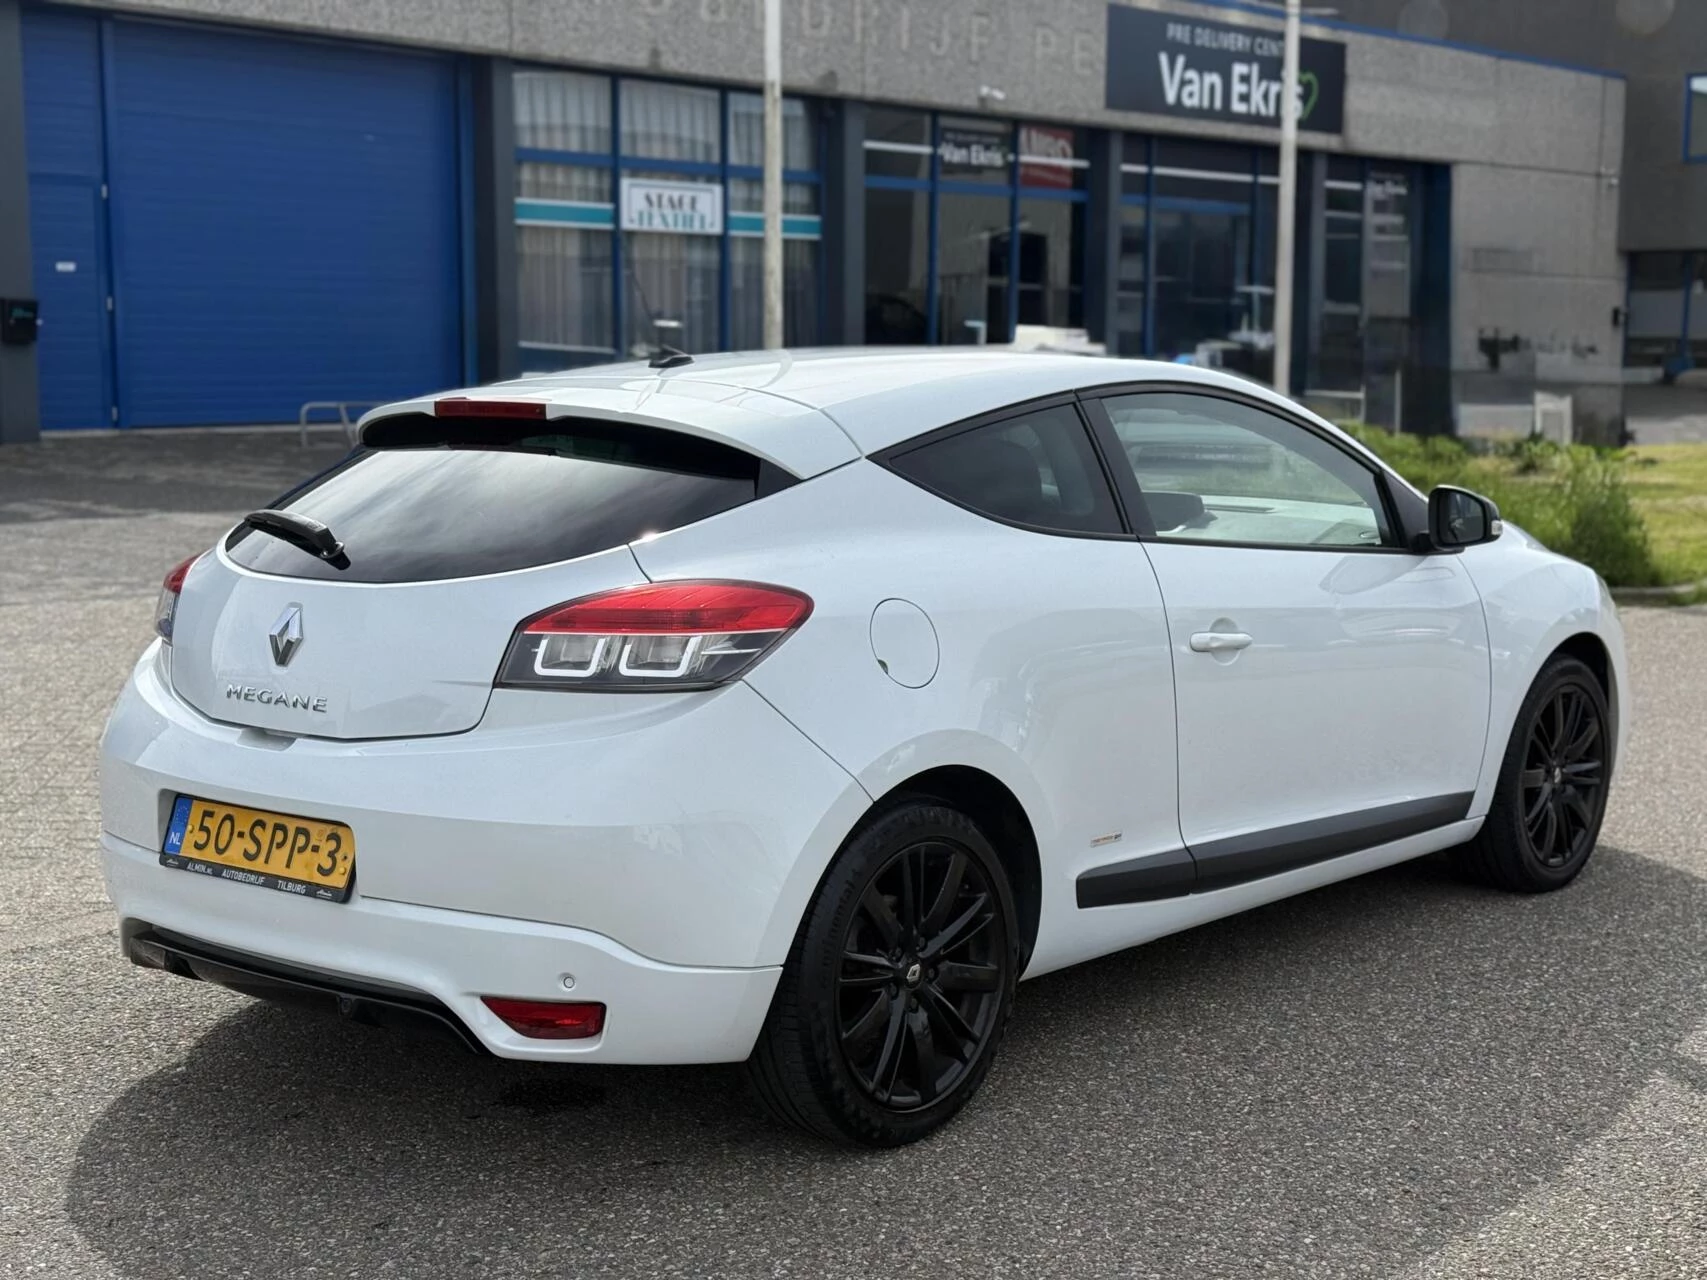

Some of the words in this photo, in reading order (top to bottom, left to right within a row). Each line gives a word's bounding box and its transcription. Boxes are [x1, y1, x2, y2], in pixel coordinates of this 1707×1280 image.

[1167, 22, 1191, 45] PRE
[1194, 26, 1253, 52] DELIVERY
[1158, 51, 1224, 112] Van
[1231, 62, 1305, 120] Ekrs
[643, 192, 700, 212] STAGE
[225, 683, 328, 714] MEGANE
[169, 830, 182, 846] NL
[192, 809, 343, 878] 50-SPP-3
[221, 869, 266, 886] AUTOBEDRIJF
[276, 879, 307, 895] TILBURG
